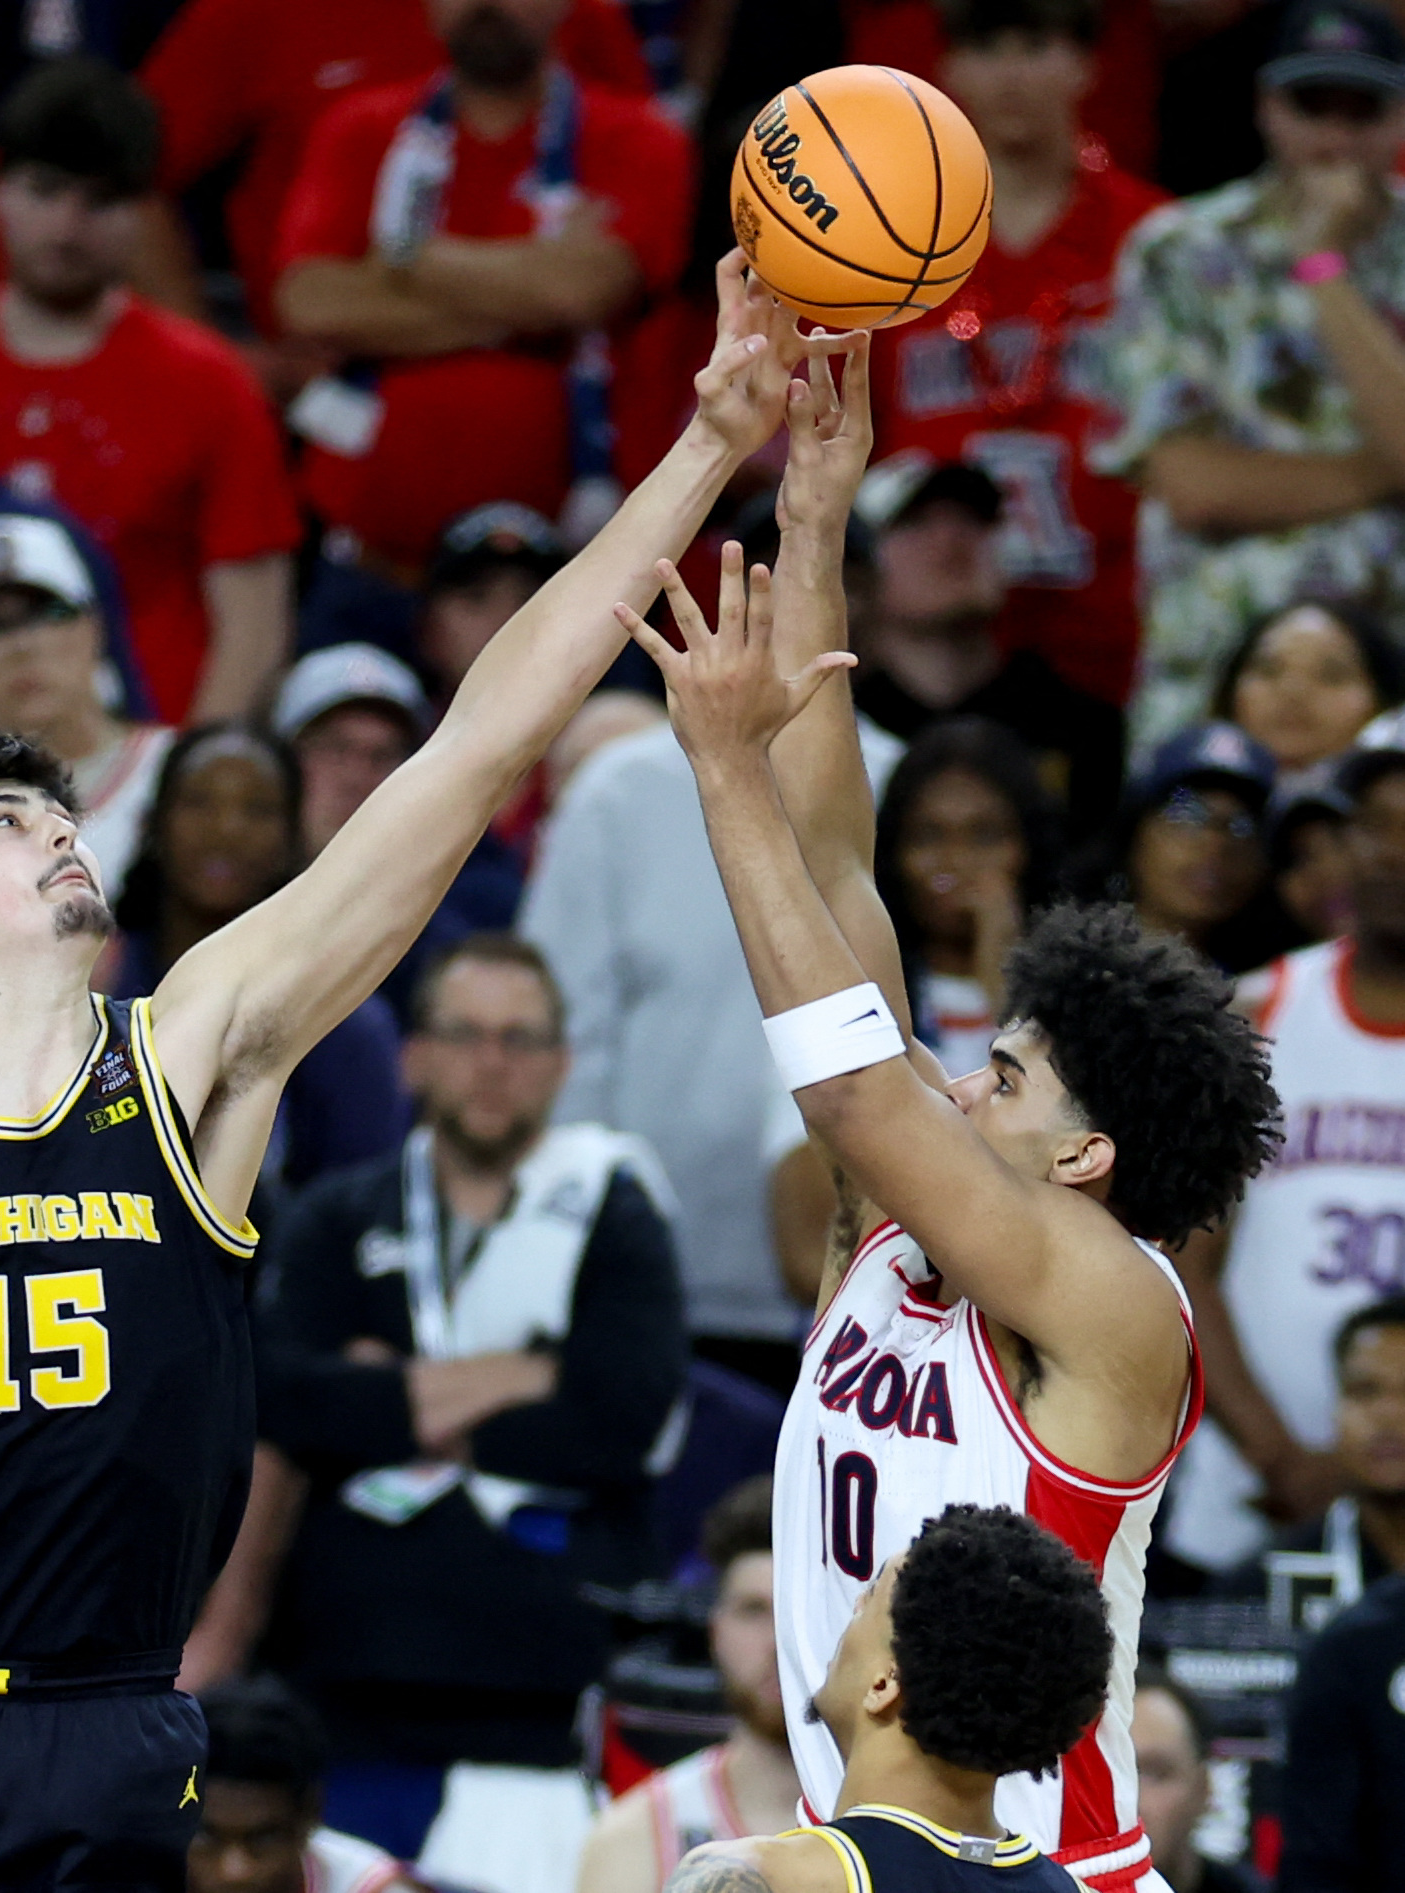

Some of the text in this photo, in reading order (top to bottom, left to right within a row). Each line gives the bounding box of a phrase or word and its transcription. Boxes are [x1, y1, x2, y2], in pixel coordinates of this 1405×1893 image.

[753, 95, 839, 234] Wilson
[95, 1052, 125, 1078] FINAL
[101, 1070, 132, 1094] FOUR
[817, 1434, 878, 1581] 10
